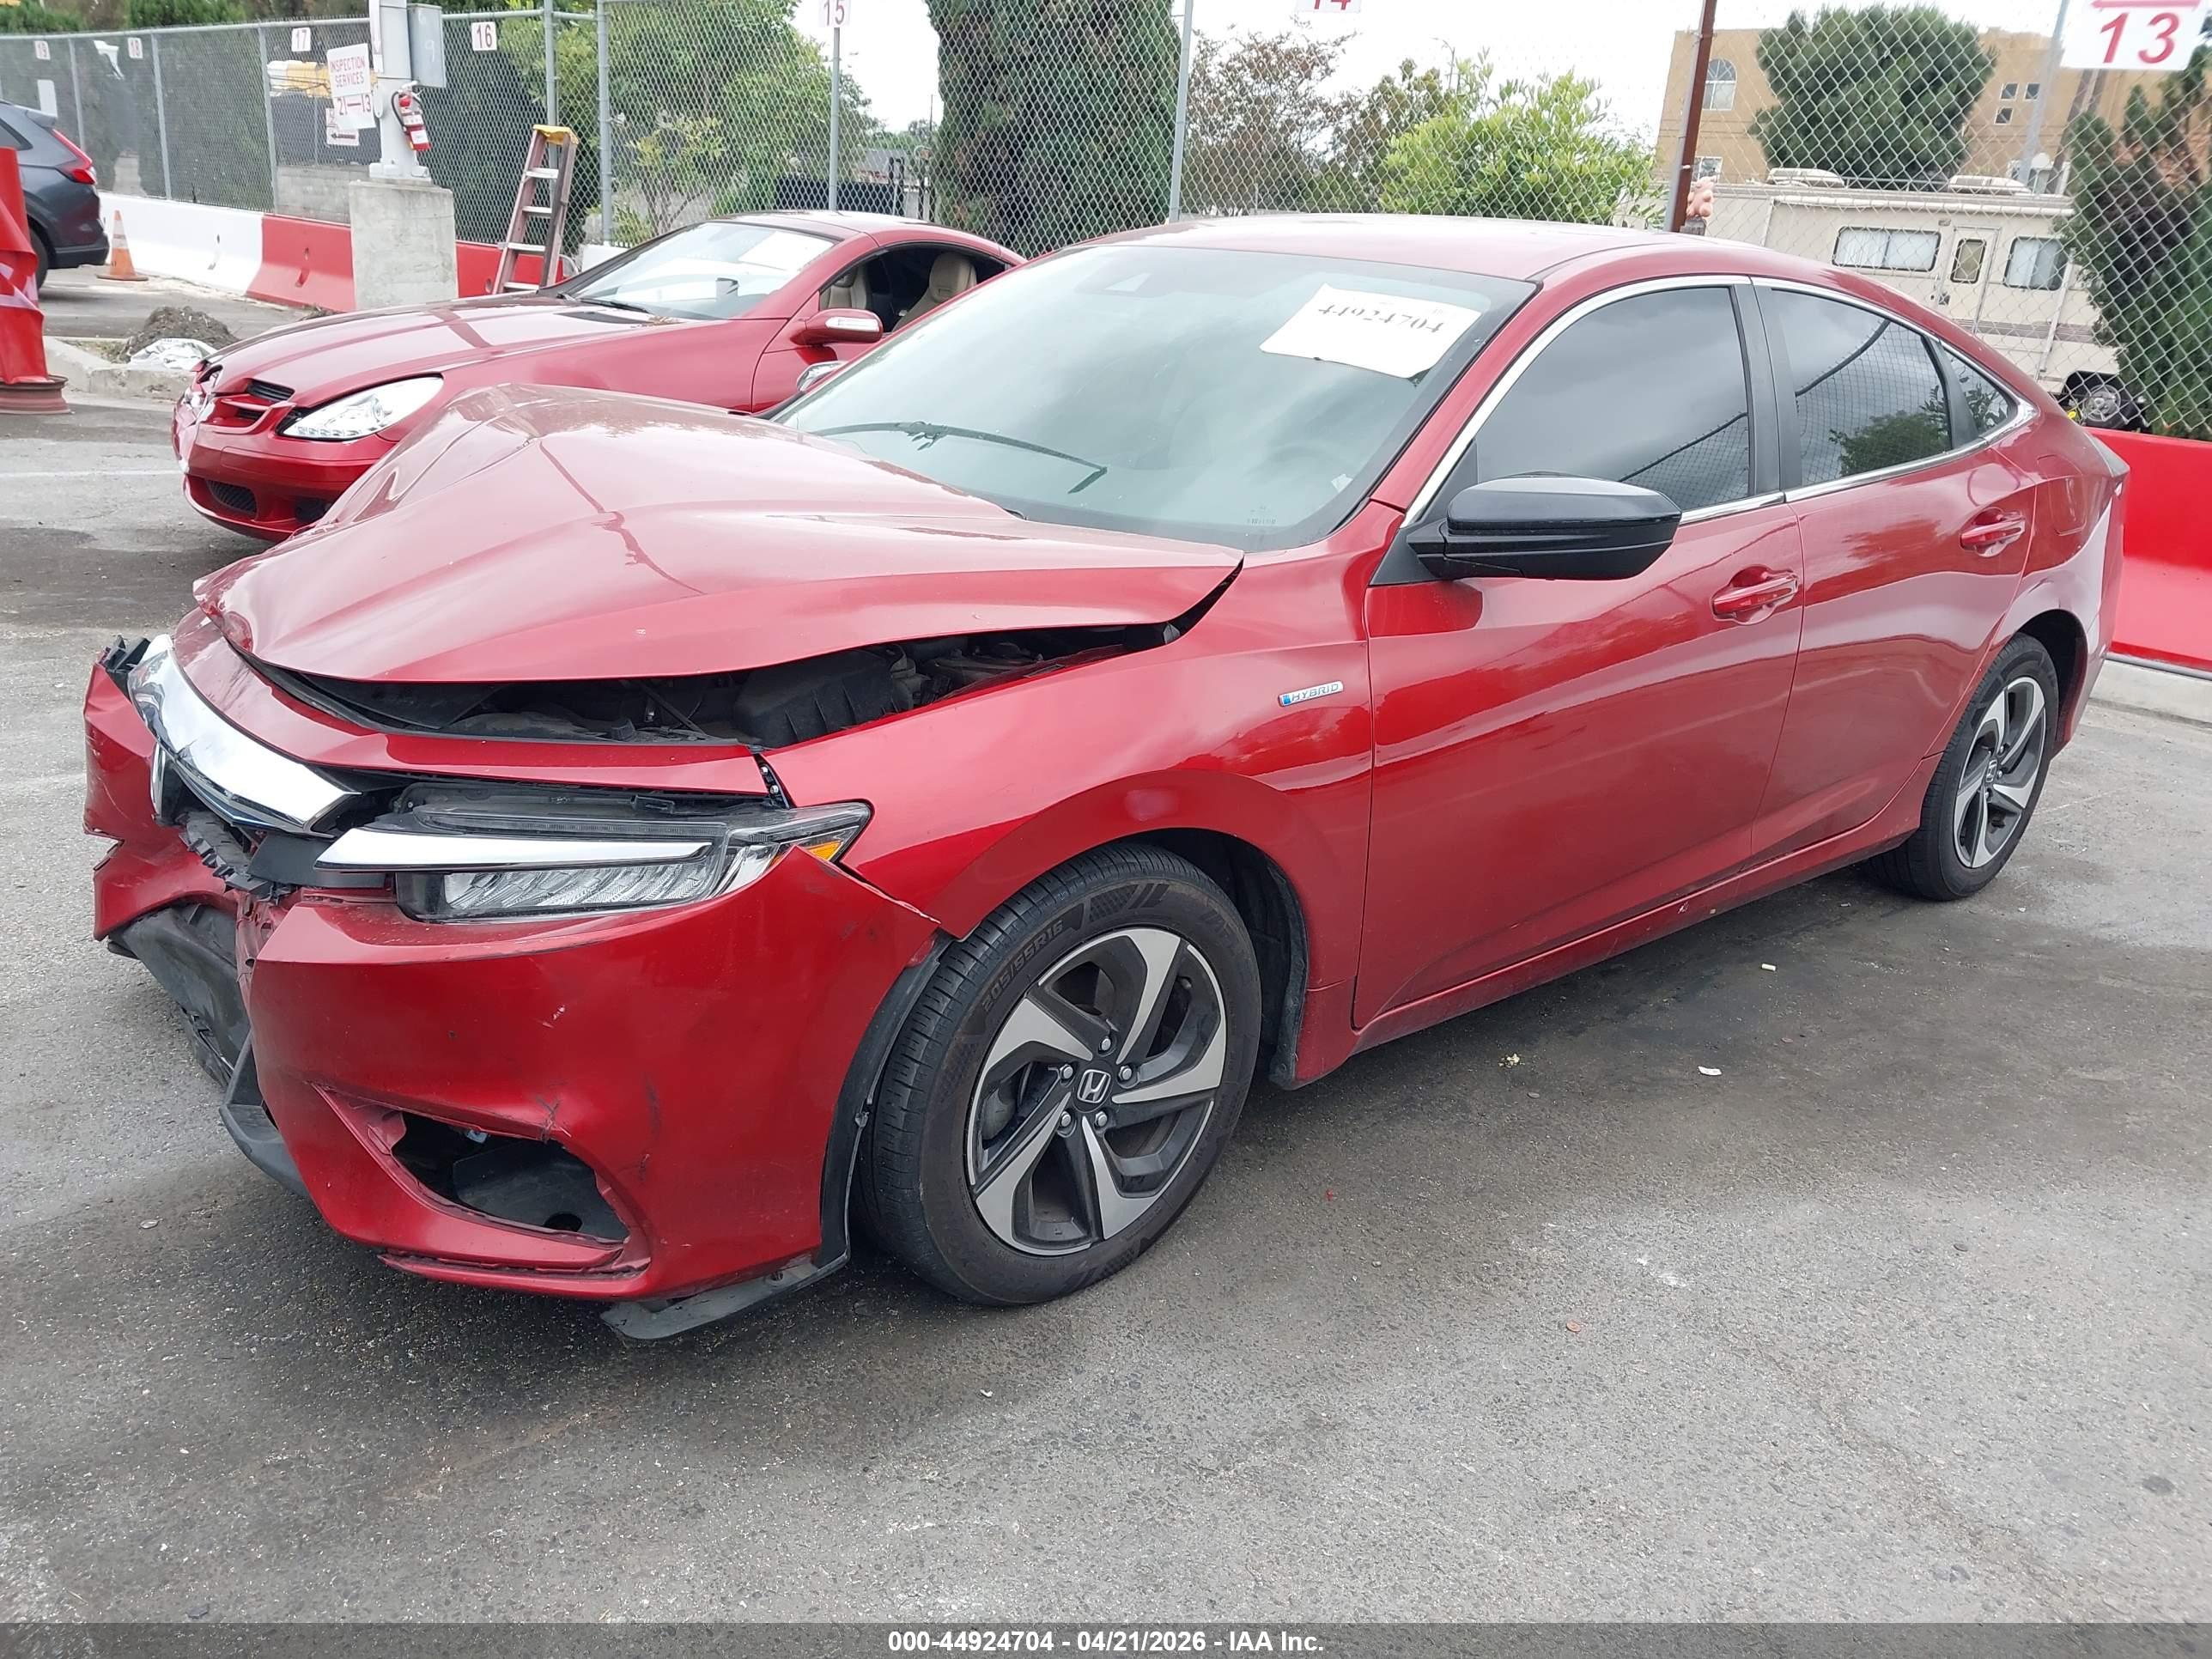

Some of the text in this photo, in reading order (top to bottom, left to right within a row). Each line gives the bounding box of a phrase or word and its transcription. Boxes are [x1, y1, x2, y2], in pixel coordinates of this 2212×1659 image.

[823, 0, 845, 27] 15
[295, 28, 308, 50] 17
[476, 23, 494, 49] 16
[2100, 11, 2180, 64] 13
[330, 56, 366, 74] INSPECTION
[335, 71, 365, 88] SERVICES
[1291, 684, 1340, 702] HYBRID
[981, 919, 1064, 1012] 205/55R16
